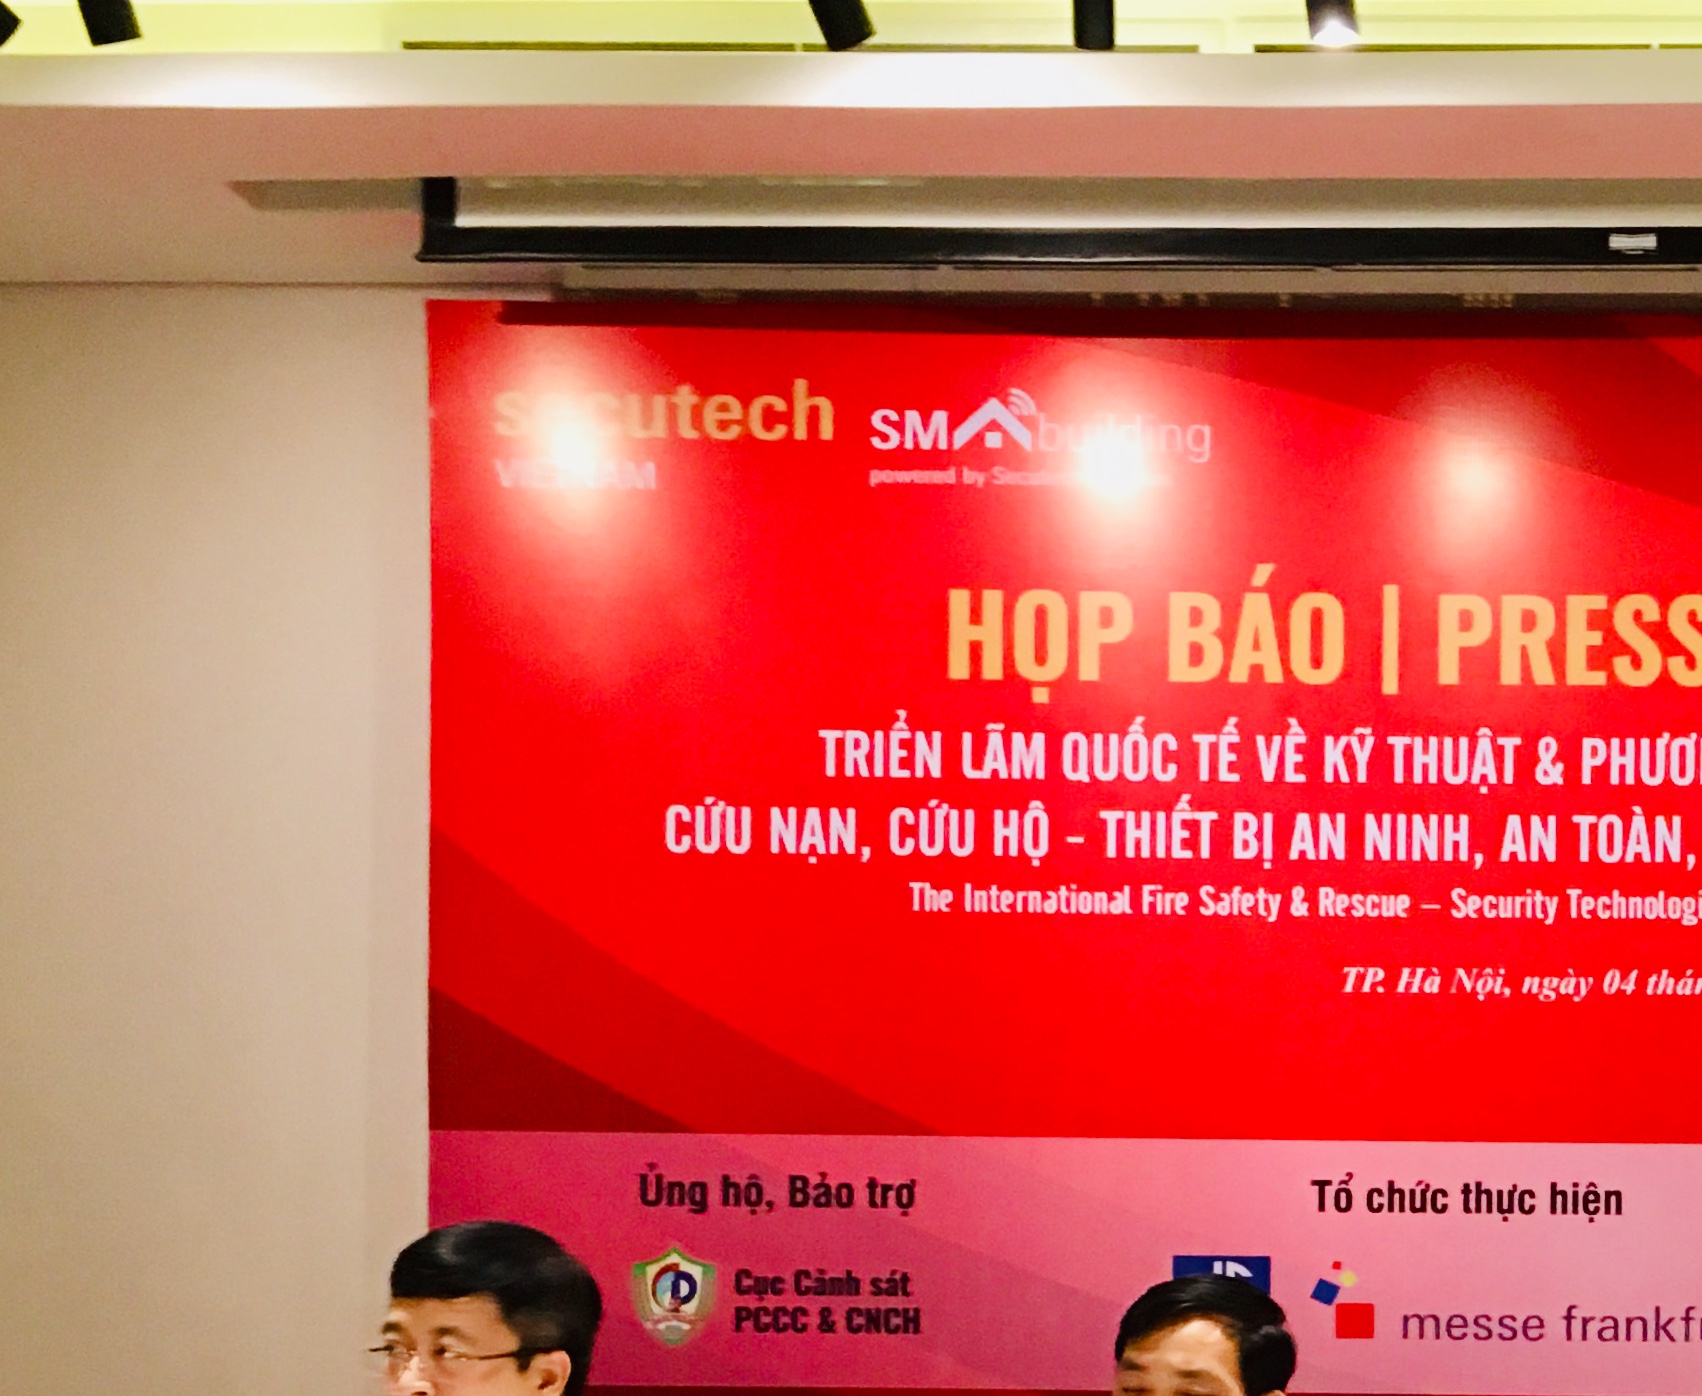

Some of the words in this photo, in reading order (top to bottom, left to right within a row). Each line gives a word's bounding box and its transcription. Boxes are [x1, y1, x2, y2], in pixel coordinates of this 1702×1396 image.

[868, 466, 957, 487] powered
[962, 466, 986, 487] by
[947, 588, 1134, 704] HỌP
[1168, 563, 1346, 685] BÁO
[818, 709, 943, 778] TRIỂN
[961, 722, 1046, 780] LÃM
[1061, 715, 1178, 784] QUỐC
[1192, 715, 1241, 783] TẾ
[1255, 716, 1307, 783] VỀ
[1323, 726, 1376, 784] KỸ
[1386, 726, 1522, 795] THUẬT
[1534, 736, 1565, 786] &
[664, 795, 752, 855] CỨU
[769, 806, 872, 864] NẠN,
[888, 799, 976, 858] CỨU
[993, 800, 1050, 867] HỘ
[1099, 793, 1218, 860] THIẾT
[1233, 812, 1273, 870] BỊ
[1288, 812, 1346, 862] AN
[1363, 813, 1485, 871] NINH,
[1499, 814, 1557, 862] AN
[1571, 804, 1697, 872] TOÀN,
[909, 881, 954, 914] The
[964, 883, 1133, 915] International
[1141, 883, 1190, 916] Fire
[1199, 884, 1282, 924] Safety
[1290, 885, 1309, 918] &
[1318, 886, 1412, 919] Rescue
[1450, 887, 1559, 925] Security
[1340, 966, 1385, 994] TP.
[1394, 966, 1441, 995] Hà
[1449, 966, 1513, 1002] Nội,
[1520, 968, 1595, 1002] ngày
[1601, 968, 1639, 996] 04
[638, 1161, 709, 1214] Ủng
[720, 1172, 775, 1216] hộ,
[788, 1171, 855, 1210] Bảo
[867, 1175, 917, 1217] trợ
[1310, 1171, 1354, 1213] Tổ
[1365, 1179, 1449, 1215] chức
[1460, 1181, 1537, 1222] thực
[1549, 1181, 1624, 1223] hiện
[868, 1267, 911, 1298] sát
[734, 1305, 808, 1334] PCCC
[816, 1307, 836, 1334] &
[845, 1306, 922, 1335] CNCH
[1401, 1312, 1546, 1342] messe
